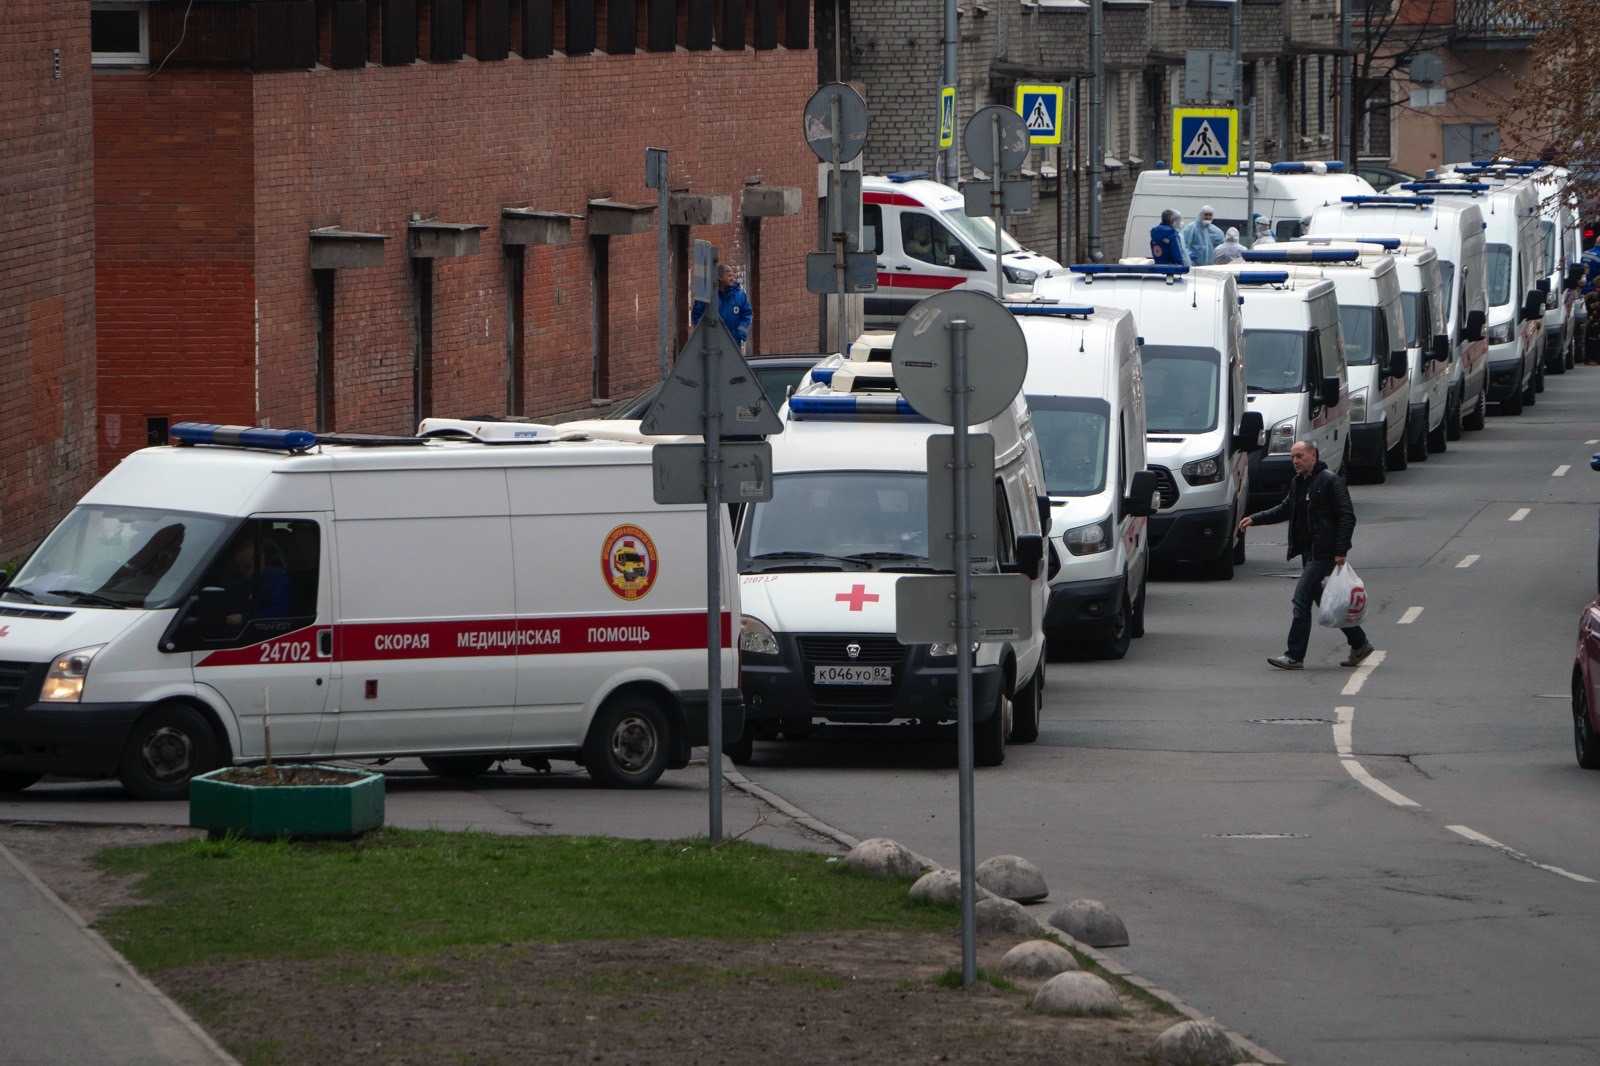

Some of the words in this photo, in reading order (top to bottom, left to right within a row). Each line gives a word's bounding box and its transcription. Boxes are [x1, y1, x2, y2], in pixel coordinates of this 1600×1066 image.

[374, 633, 430, 650] СКОРАЯ
[457, 629, 561, 650] МЕДИЦИНСКАЯ
[587, 626, 650, 644] ПОМОЩЬ
[259, 641, 311, 662] 24702
[874, 667, 887, 677] 82
